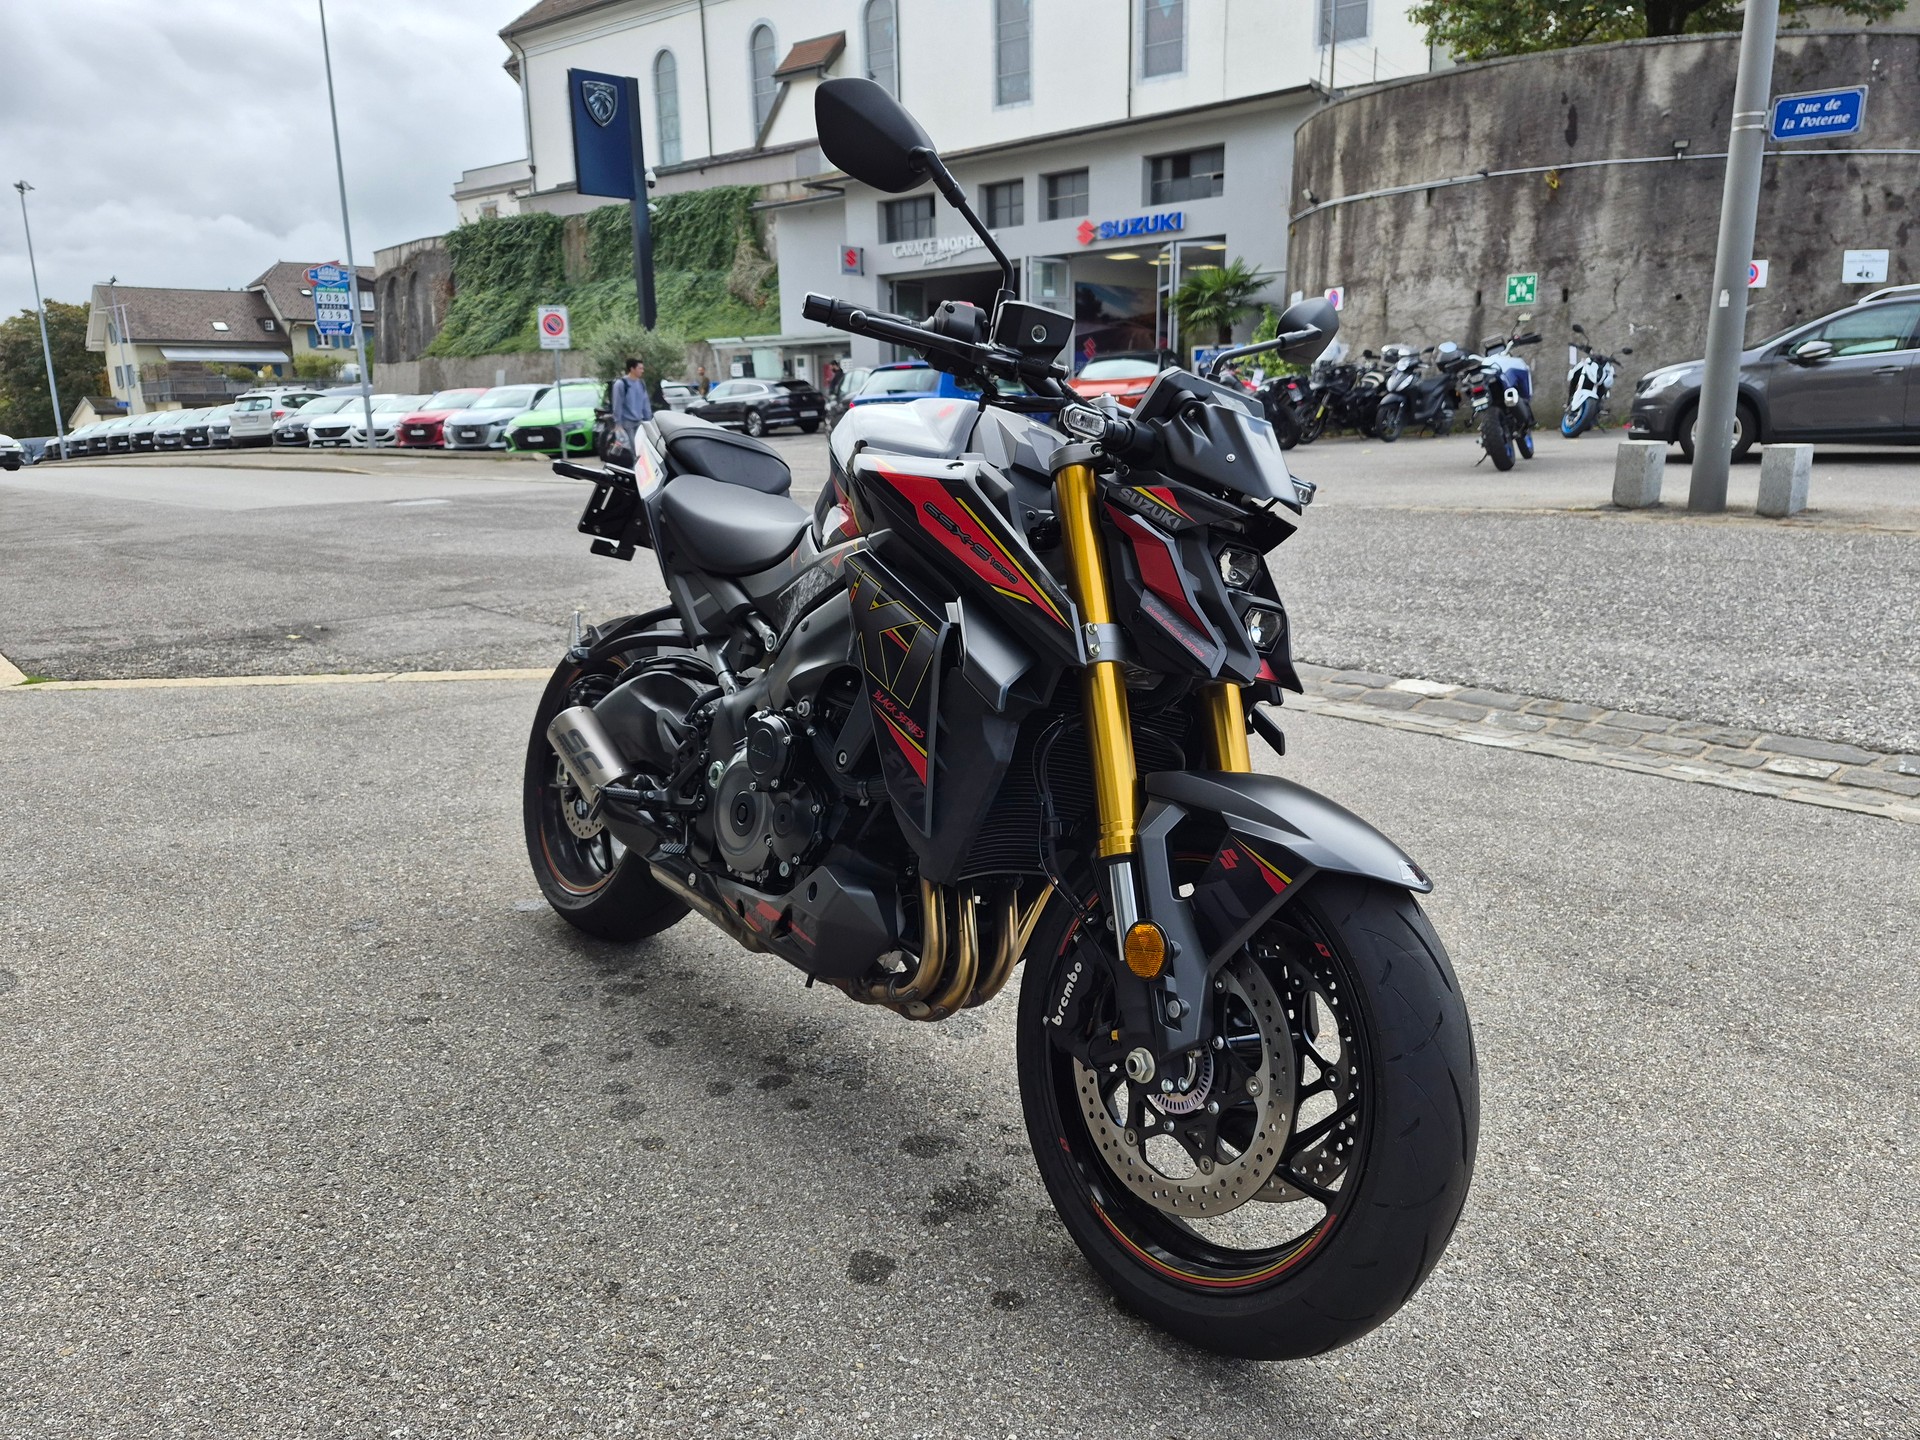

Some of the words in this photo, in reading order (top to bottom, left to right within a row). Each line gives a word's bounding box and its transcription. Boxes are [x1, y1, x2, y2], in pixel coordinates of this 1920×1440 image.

[1781, 117, 1796, 130] la
[1799, 113, 1851, 128] Poterne
[1794, 102, 1821, 114] Rue
[1824, 98, 1842, 111] de
[892, 240, 938, 258] GARAGE
[938, 232, 998, 254] MODERE
[1100, 212, 1184, 239] SUZUKI
[1119, 488, 1181, 529] SUZUKI
[923, 501, 992, 562] GSX-S
[989, 556, 1019, 584] 1000
[1145, 605, 1163, 622] SWISS
[1162, 620, 1183, 640] SPECIAL
[1183, 638, 1205, 658] EDITION
[872, 689, 898, 713] BLACK
[895, 711, 926, 738] SERIES
[560, 728, 604, 775] SC
[1051, 962, 1082, 1026] brembo
